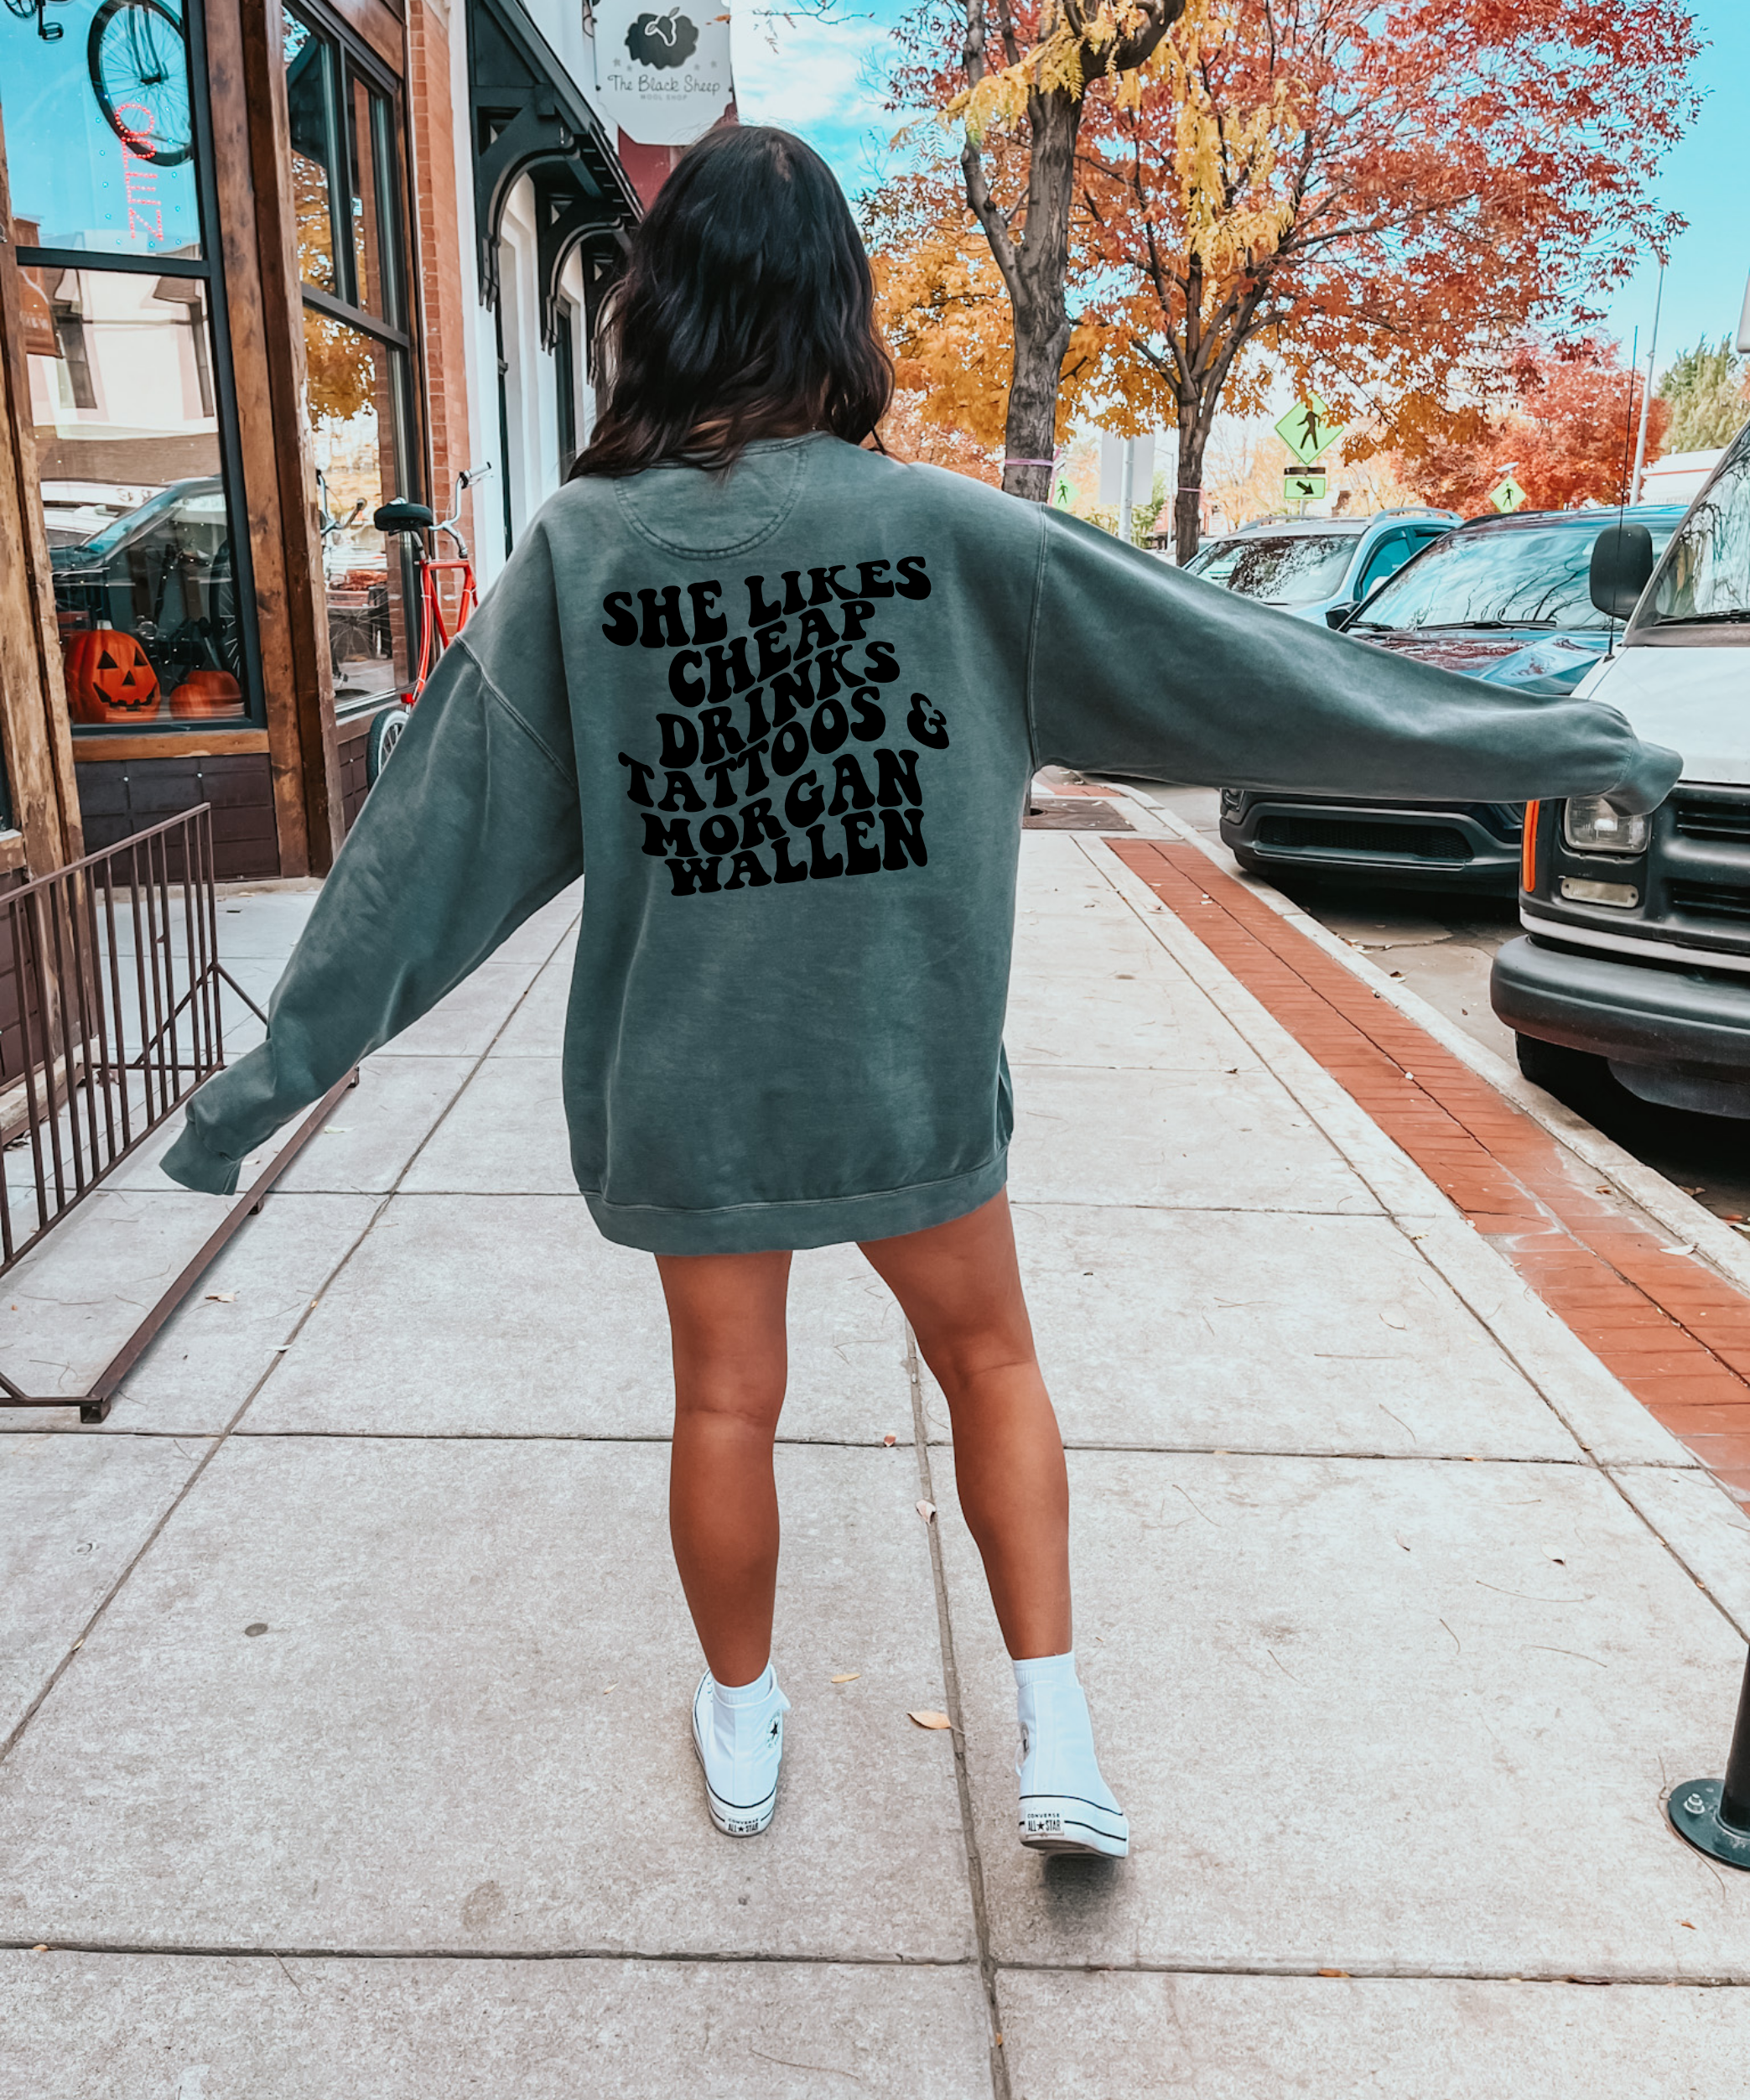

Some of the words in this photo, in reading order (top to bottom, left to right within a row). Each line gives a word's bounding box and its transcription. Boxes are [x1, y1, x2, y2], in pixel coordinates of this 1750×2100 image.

[607, 75, 633, 91] The
[638, 74, 679, 92] Black
[683, 74, 721, 96] Sheep
[116, 102, 164, 242] OPEN
[601, 580, 728, 648] SHE
[744, 556, 932, 628] LIKES
[668, 600, 875, 708] CHEAP
[618, 686, 886, 813] TATTOOS
[906, 692, 950, 750] &
[656, 641, 901, 769] DRINKS
[641, 748, 922, 857] MORGAN
[664, 808, 928, 897] WALLEN
[1046, 1819, 1061, 1832] STAR
